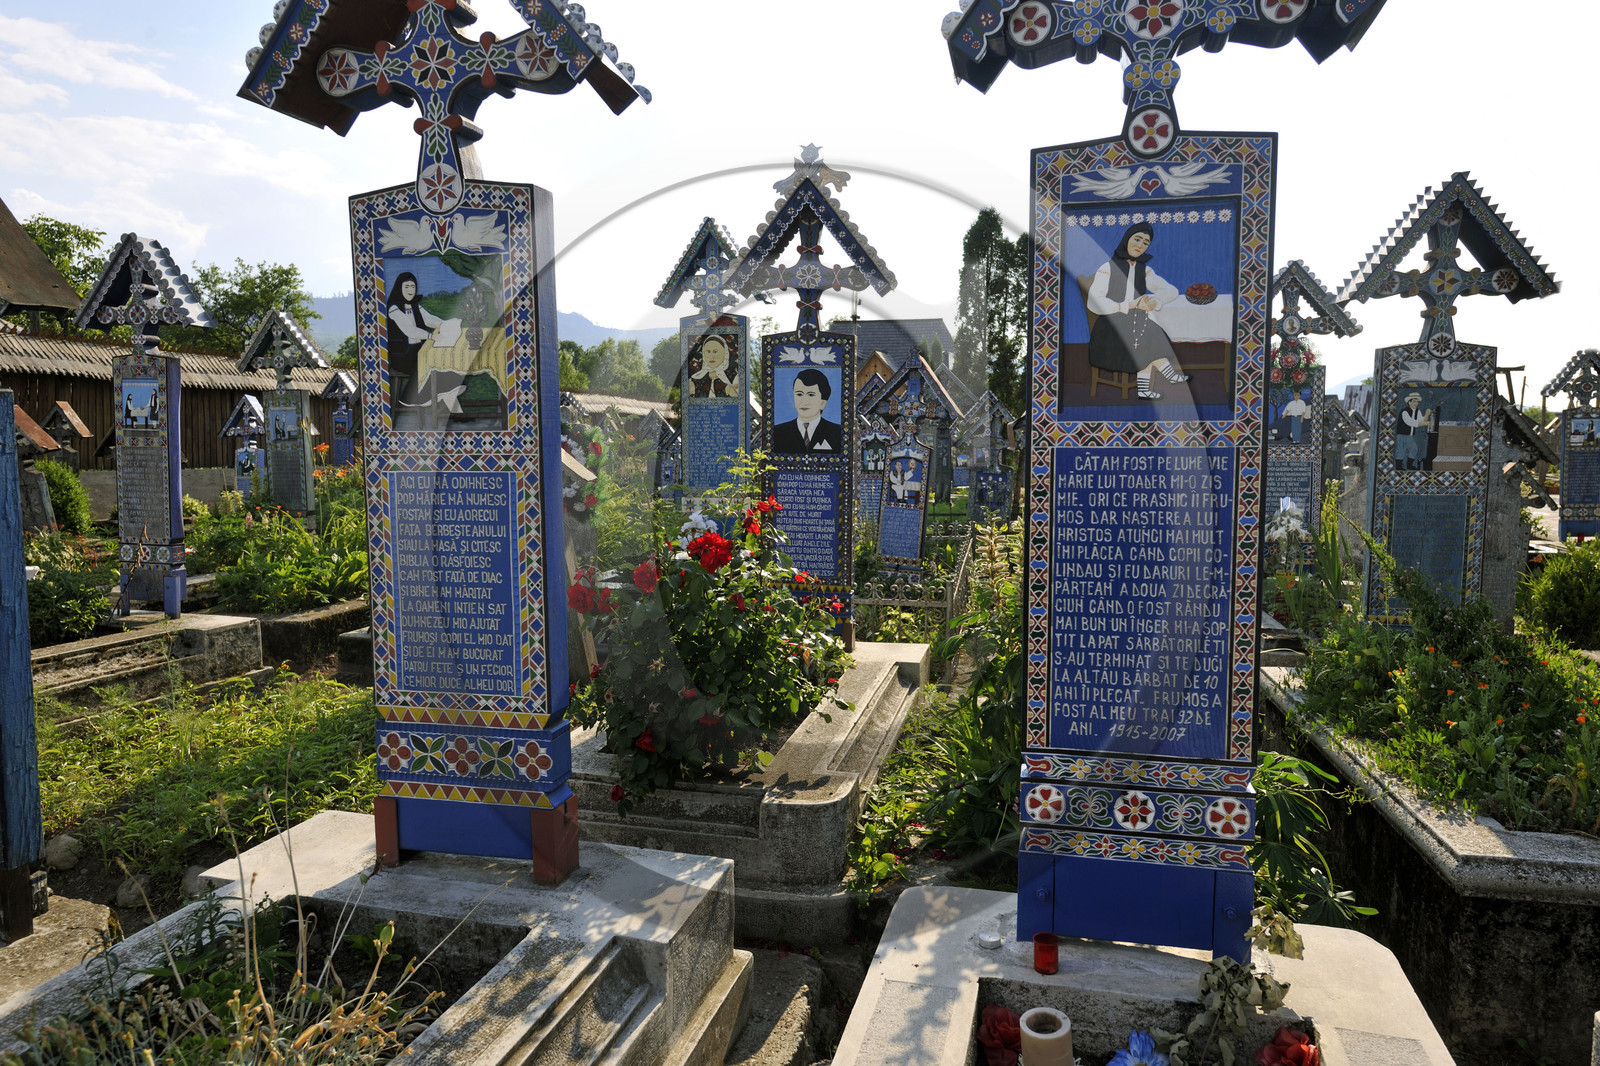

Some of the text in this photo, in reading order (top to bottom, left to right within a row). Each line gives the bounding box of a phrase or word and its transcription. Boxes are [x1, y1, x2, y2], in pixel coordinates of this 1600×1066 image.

[1102, 456, 1120, 470] AM
[1123, 456, 1154, 470] FOST
[1158, 456, 1172, 470] PE
[1174, 456, 1202, 470] LUME
[1208, 456, 1228, 470] VIE
[400, 476, 414, 489] ACI
[418, 477, 430, 488] EU
[451, 477, 503, 490] ODIHNESC
[1098, 475, 1116, 489] LUI
[1119, 475, 1167, 489] TOADER
[1171, 475, 1196, 489] MI-O
[1201, 475, 1222, 489] ZIS
[397, 493, 414, 505] POP
[466, 493, 506, 506] NUMESC
[1089, 493, 1108, 506] ORI
[1113, 493, 1127, 507] CE
[1133, 493, 1188, 507] PRASNIC
[1202, 493, 1232, 507] FRU-
[445, 510, 456, 521] EU
[1057, 510, 1083, 524] MOS
[1091, 511, 1118, 525] DAR
[1197, 511, 1218, 526] LUI
[400, 524, 421, 536] FATA
[1057, 528, 1223, 545] HRISTOS ATUNCI MAI MULT
[399, 539, 417, 551] STAU
[420, 540, 429, 550] LA
[471, 540, 502, 552] CITESC
[400, 554, 429, 566] BIBLIA
[432, 555, 438, 567] O
[1169, 548, 1200, 562] COPII
[1205, 548, 1228, 562] CO-
[400, 570, 419, 581] CAM
[422, 570, 443, 582] FOST
[468, 572, 479, 582] DE
[482, 572, 502, 583] DIAC
[1056, 563, 1102, 578] LINDAU
[1125, 564, 1139, 579] EU
[1143, 565, 1189, 580] DARURI
[411, 586, 430, 597] BINE
[1120, 583, 1128, 596] A
[1133, 583, 1166, 597] DOUA
[1173, 584, 1184, 597] ZI
[1188, 584, 1200, 598] DE
[402, 601, 414, 612] LA
[416, 601, 451, 613] OAMENI
[488, 603, 507, 615] SAT
[1128, 601, 1134, 615] O
[1138, 601, 1172, 615] FOST
[402, 616, 450, 628] DUMNEZEU
[470, 618, 501, 630] AJUTAT
[1055, 616, 1077, 630] MAI
[1082, 618, 1106, 631] BUN
[441, 633, 462, 644] COPII
[464, 633, 476, 644] EL
[496, 635, 513, 646] DAT
[1055, 634, 1076, 648] TIT
[413, 646, 424, 658] DE
[427, 646, 434, 658] EI
[463, 648, 503, 661] BUCURAT
[404, 660, 428, 672] PATRU
[431, 662, 453, 673] FETE
[466, 664, 479, 675] UN
[481, 664, 514, 676] FECIOR
[1054, 652, 1084, 666] S-AU
[1089, 653, 1151, 668] TERMINAT
[1176, 656, 1188, 671] TE
[1054, 668, 1070, 683] LA
[1184, 675, 1199, 689] DE
[1204, 676, 1218, 689] 10
[497, 680, 514, 692] DOR
[1054, 686, 1077, 700] ANI
[1154, 691, 1209, 708] FRUMOS
[1212, 694, 1222, 708] A
[1054, 702, 1086, 718] FOST
[1110, 706, 1136, 721] MEU
[1143, 708, 1174, 723] TRAI
[1177, 710, 1194, 725] 92
[1196, 711, 1211, 725] DE
[1109, 723, 1188, 741] 1915-2007
